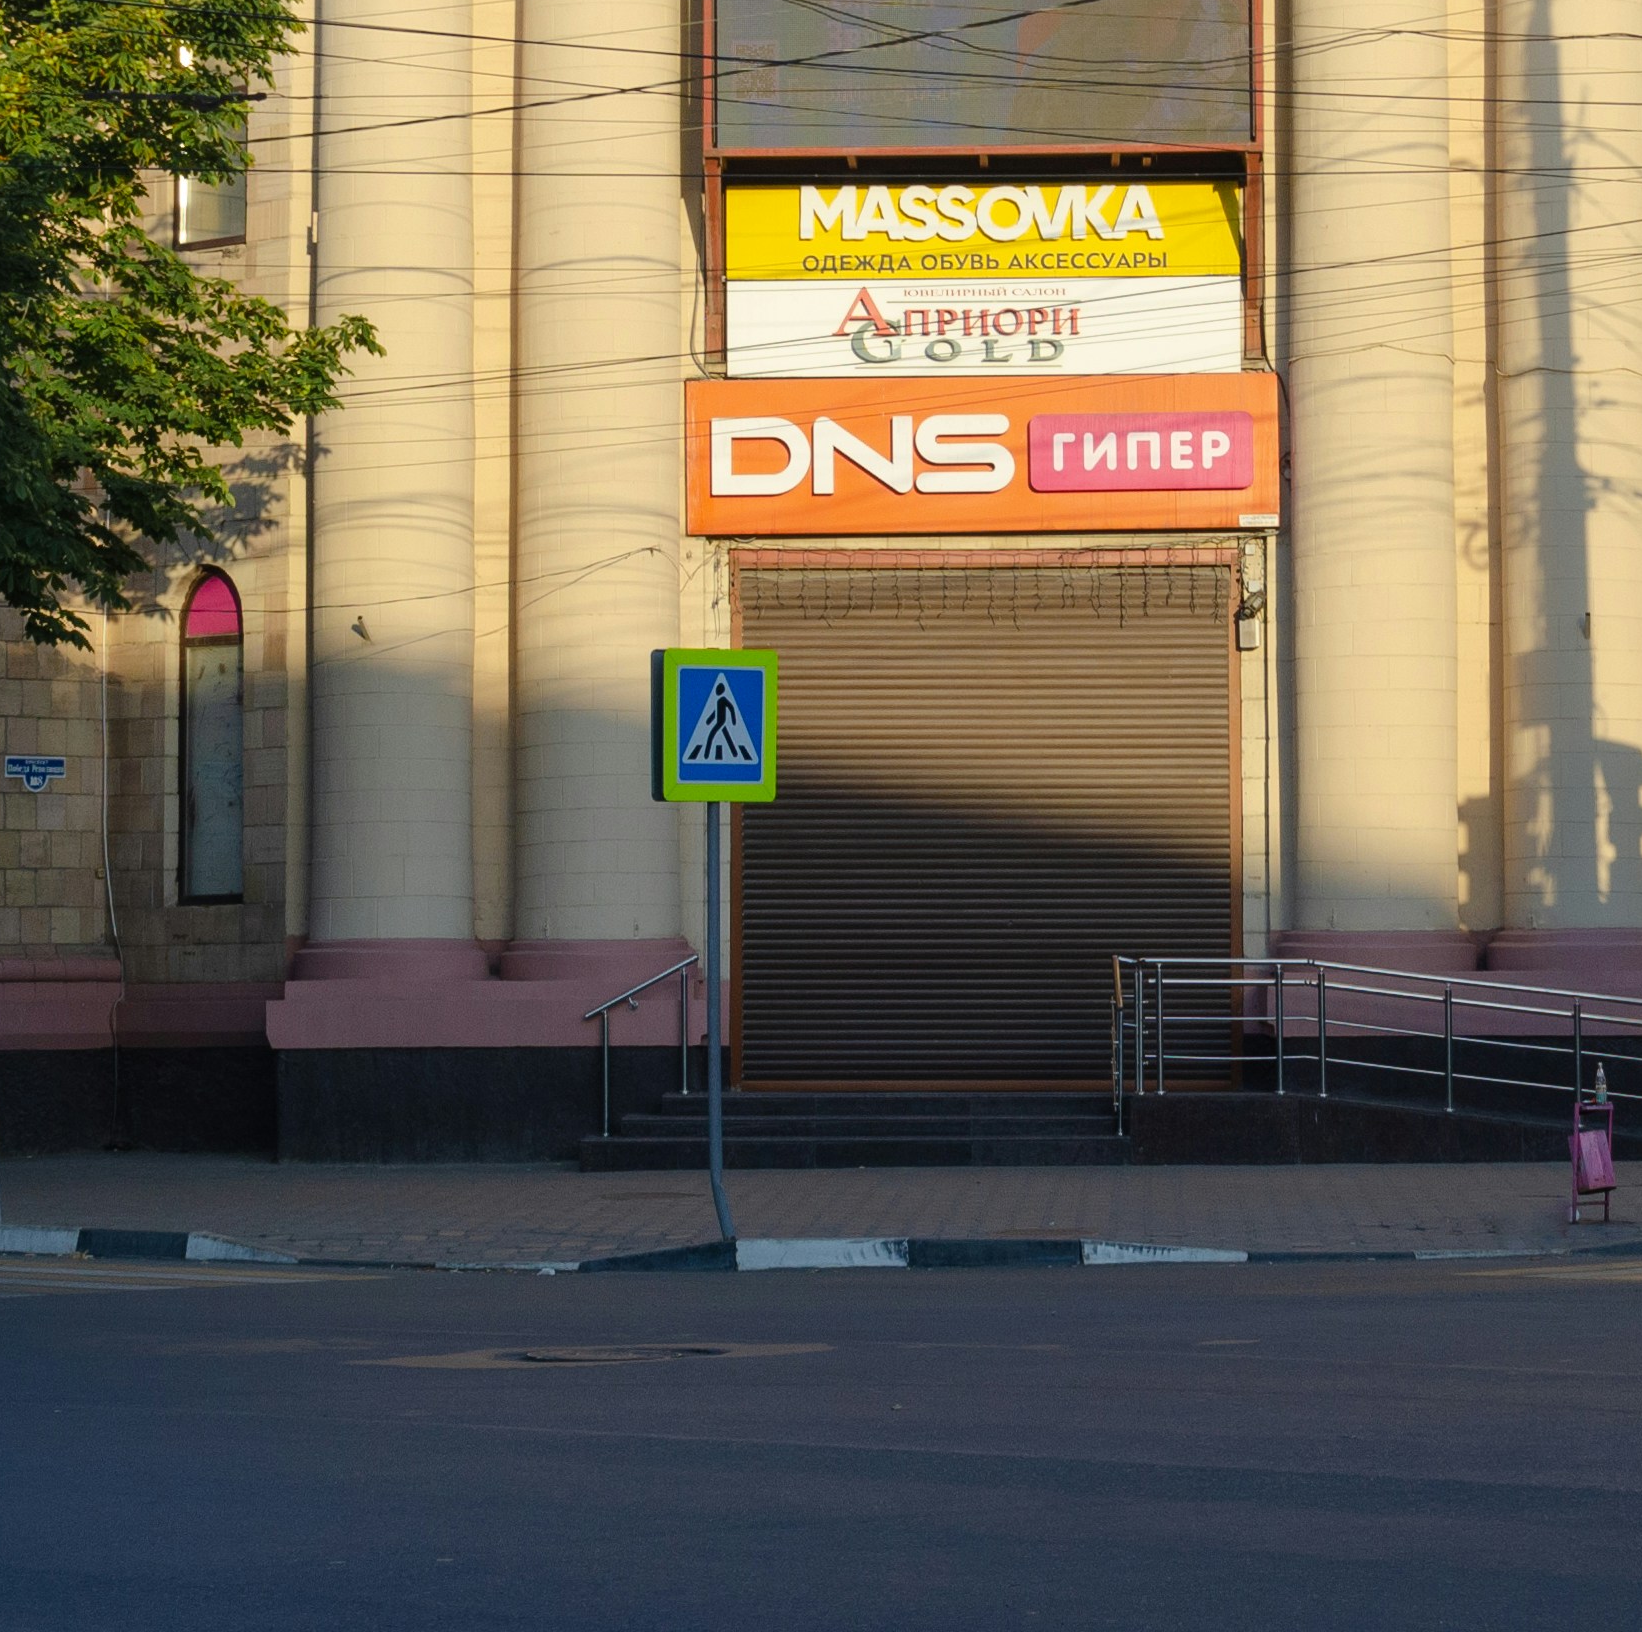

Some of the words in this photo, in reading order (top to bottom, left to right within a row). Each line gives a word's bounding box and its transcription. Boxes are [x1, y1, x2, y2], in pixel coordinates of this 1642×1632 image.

[798, 183, 1165, 242] MASSOVKA
[802, 254, 912, 274] ОДЕЖДА
[920, 253, 999, 271] ОБУВЬ
[1008, 251, 1169, 271] АКСЕССУАРЫ
[903, 286, 1007, 297] ЮВЕЛИРНЫЙ
[1012, 288, 1067, 296] САЛОН
[851, 318, 1065, 364] GOLD
[711, 413, 1016, 498] DNS
[1051, 429, 1232, 473] ГИПЕР
